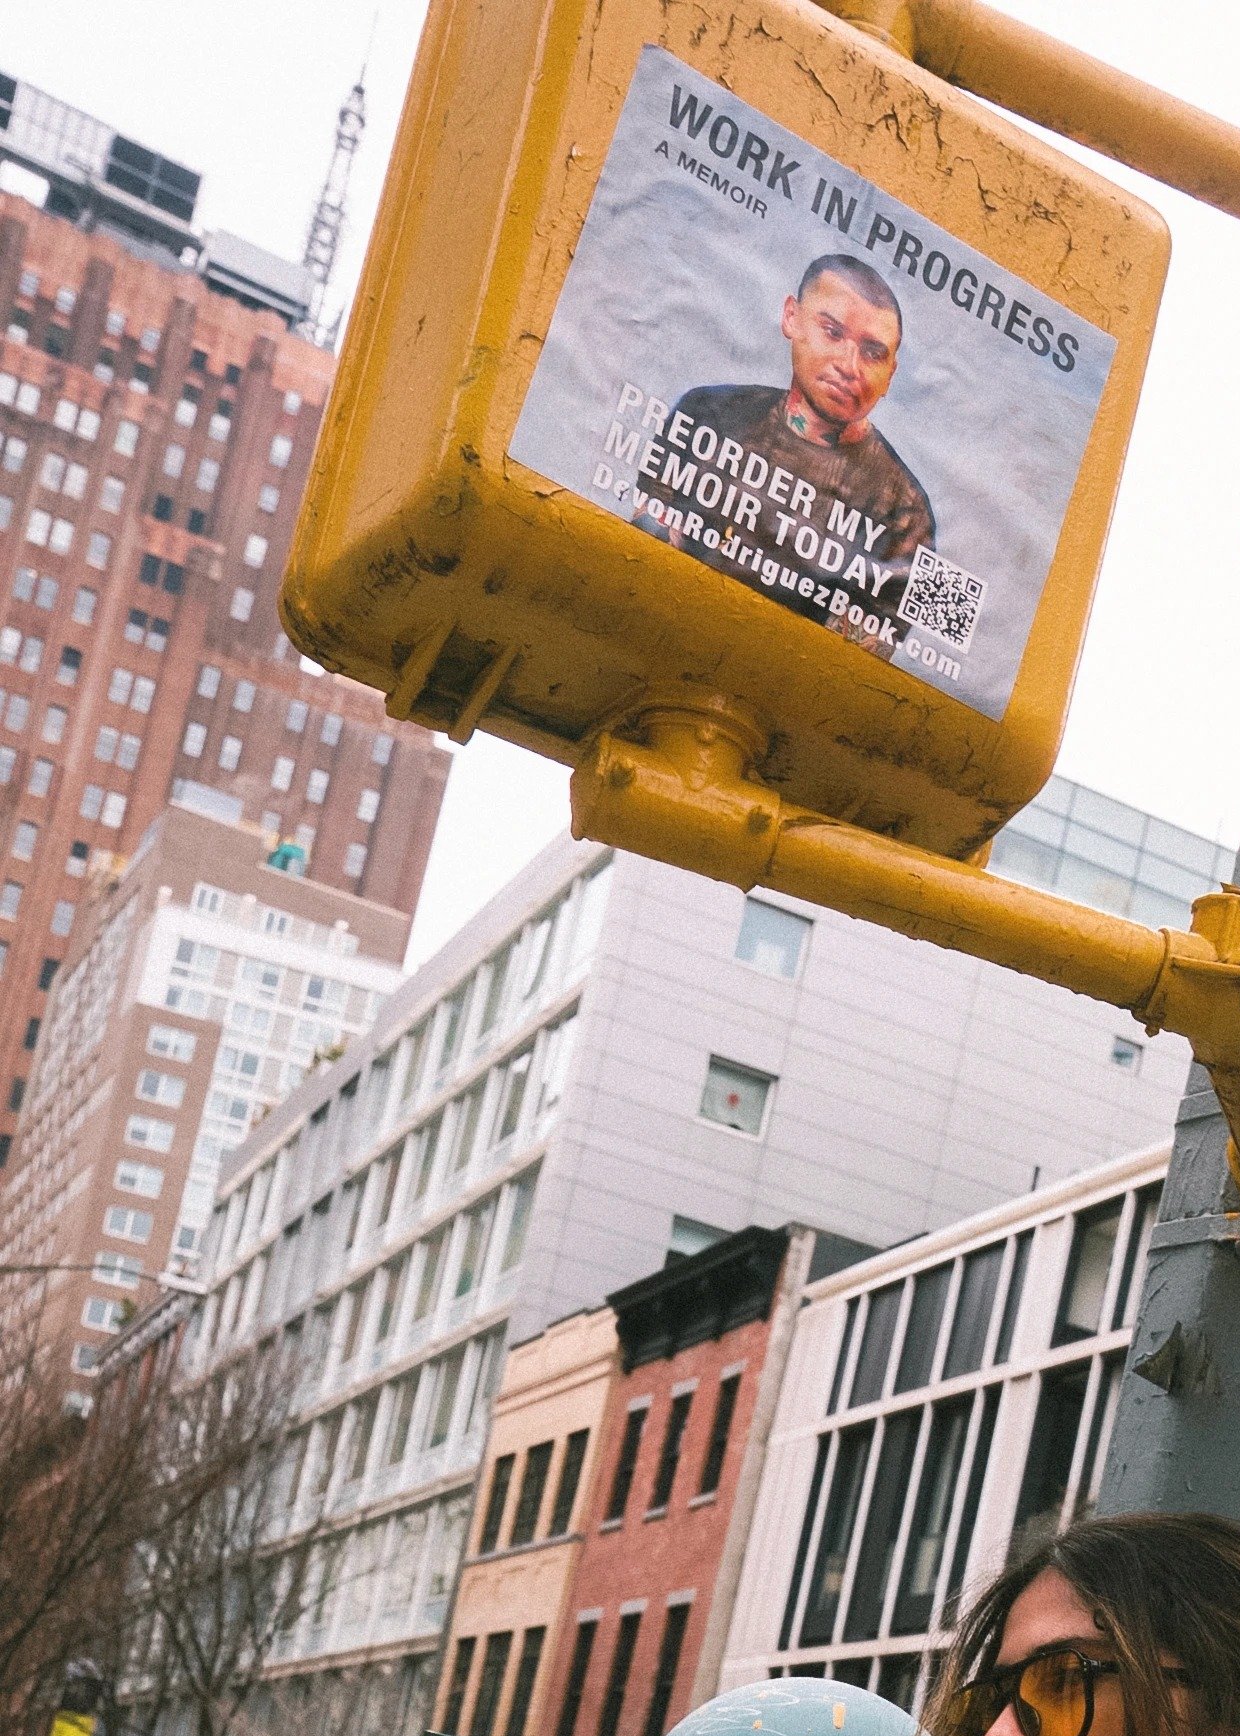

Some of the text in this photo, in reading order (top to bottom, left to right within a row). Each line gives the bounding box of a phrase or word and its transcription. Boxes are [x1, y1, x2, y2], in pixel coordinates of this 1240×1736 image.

[654, 139, 768, 220] A MEMOIR
[667, 84, 1081, 374] WORK IN PROGRESS
[604, 421, 894, 600] MEMOIR TODAY
[616, 381, 887, 554] PREORDER MY
[591, 461, 962, 683] DevonRodriguezBook.com
